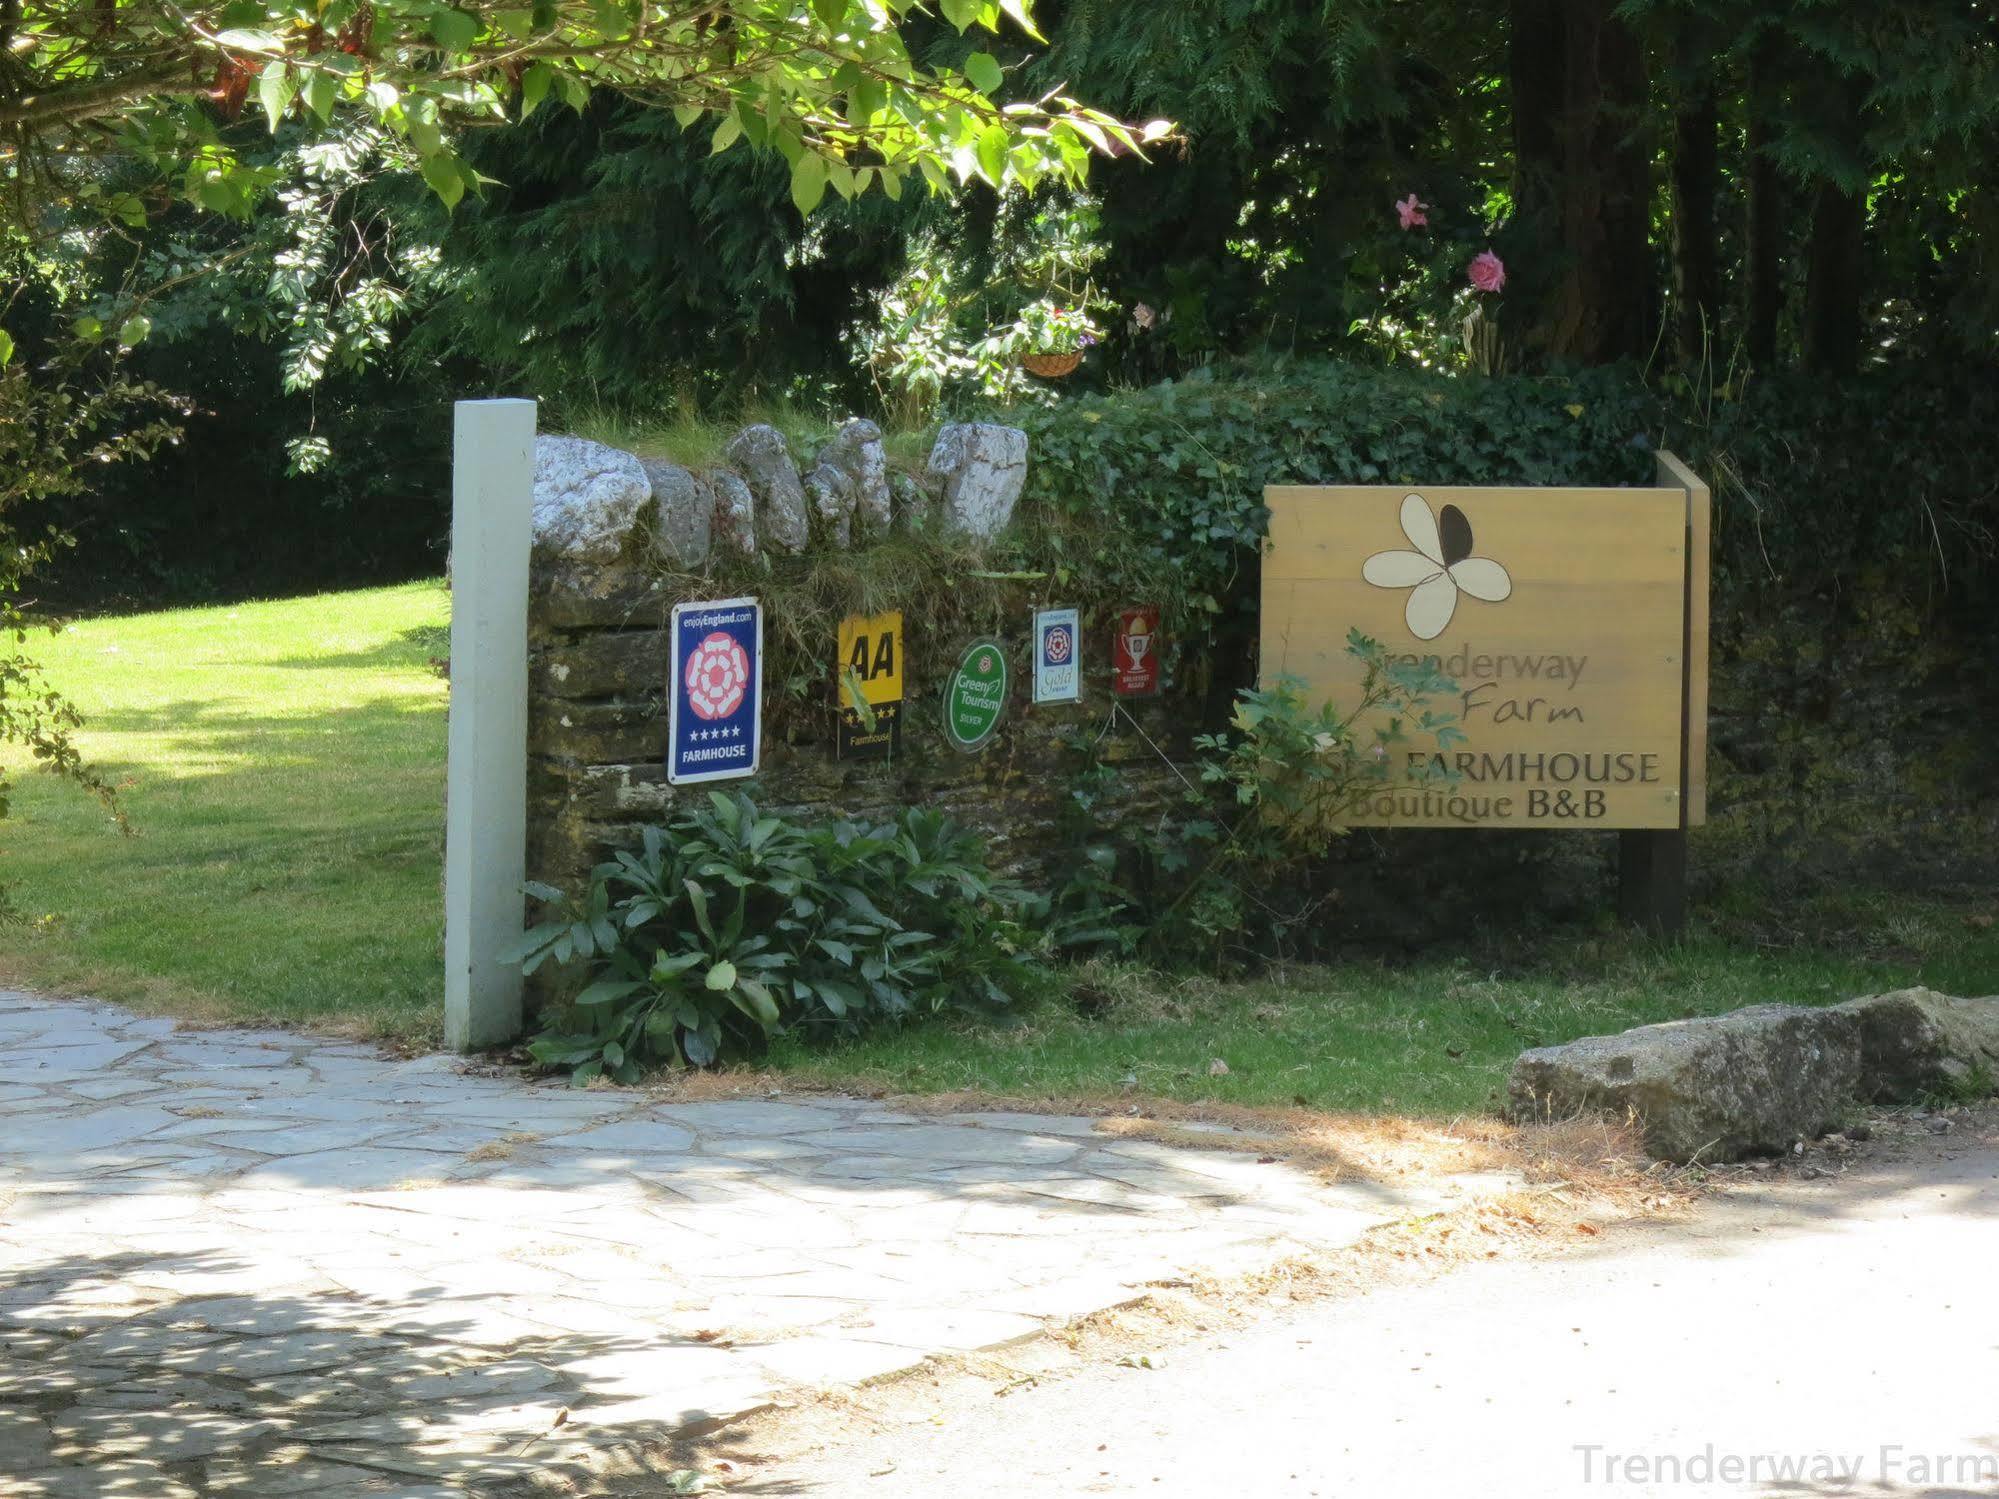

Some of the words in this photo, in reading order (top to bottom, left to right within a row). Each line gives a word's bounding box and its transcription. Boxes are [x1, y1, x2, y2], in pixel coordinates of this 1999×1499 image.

[683, 612, 752, 629] enjoyEngland.com
[850, 631, 894, 681] AA
[958, 675, 988, 693] Green
[961, 691, 1000, 711] Tourism
[1461, 681, 1584, 724] Farm
[682, 744, 746, 763] FARMHOUSE
[1407, 752, 1660, 784] FARMHOUSE
[1527, 788, 1607, 819] B&B
